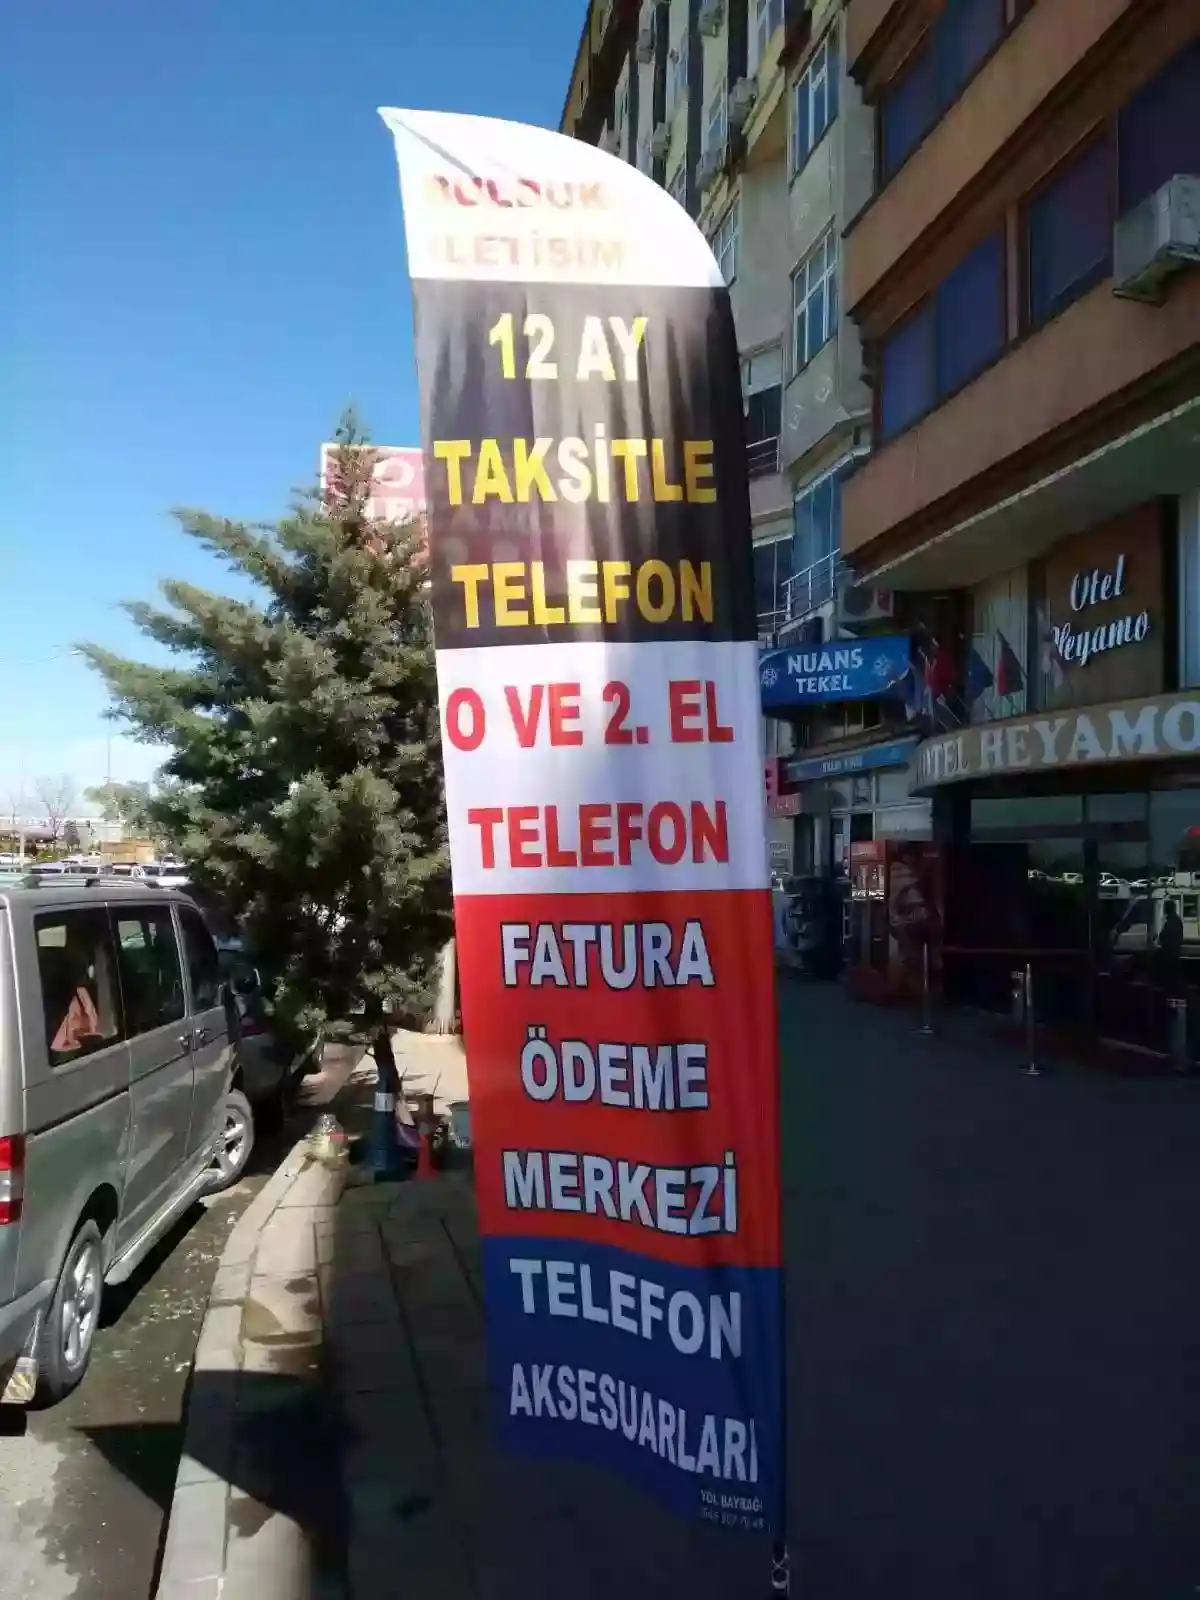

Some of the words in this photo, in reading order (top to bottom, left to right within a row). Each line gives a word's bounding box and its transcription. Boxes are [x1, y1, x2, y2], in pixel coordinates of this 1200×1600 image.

[488, 313, 560, 380] 12
[576, 314, 649, 381] AY
[433, 422, 717, 506] TAKSİTLE
[452, 559, 714, 629] TELEFON
[1070, 553, 1126, 612] Otel
[788, 648, 864, 675] NUANS
[796, 675, 853, 694] TEKEL
[504, 682, 583, 748] VE
[602, 680, 649, 745] 2.
[669, 680, 734, 743] EL
[979, 700, 1200, 769] HEYAMO
[468, 800, 730, 869] TELEFON
[501, 918, 716, 990] FATURA
[520, 1024, 709, 1111] ÖDEME
[502, 1150, 738, 1235] MERKEZİ
[509, 1257, 742, 1361] TELEFON
[509, 1362, 758, 1483] AKSESUARLARI
